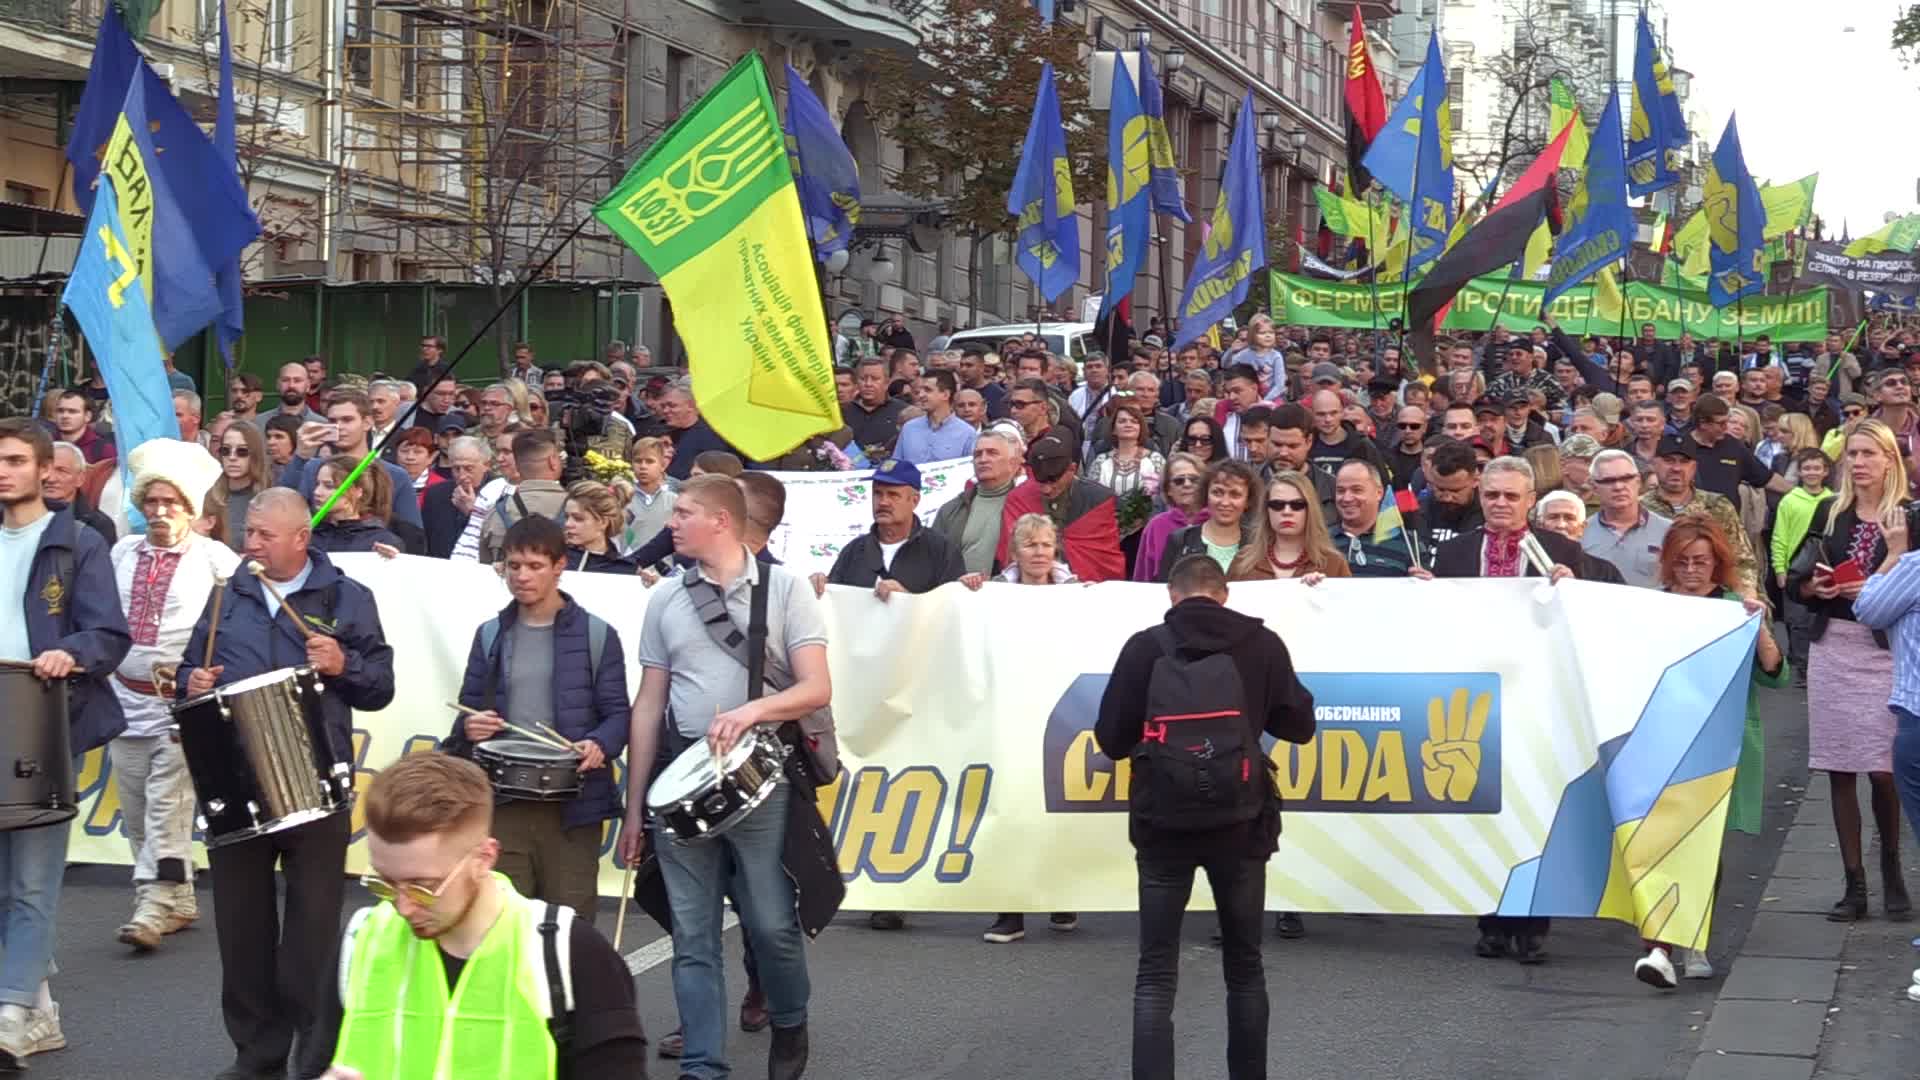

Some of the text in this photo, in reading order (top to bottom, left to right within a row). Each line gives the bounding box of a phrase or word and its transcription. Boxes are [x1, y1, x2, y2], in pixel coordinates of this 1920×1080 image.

[738, 237, 768, 316] приватних
[1291, 287, 1408, 313] ФЕРМЕ
[1552, 294, 1713, 322] ДЕБАНУ
[740, 315, 776, 373] України
[752, 243, 793, 314] Асоціація
[785, 313, 831, 385] фермерів
